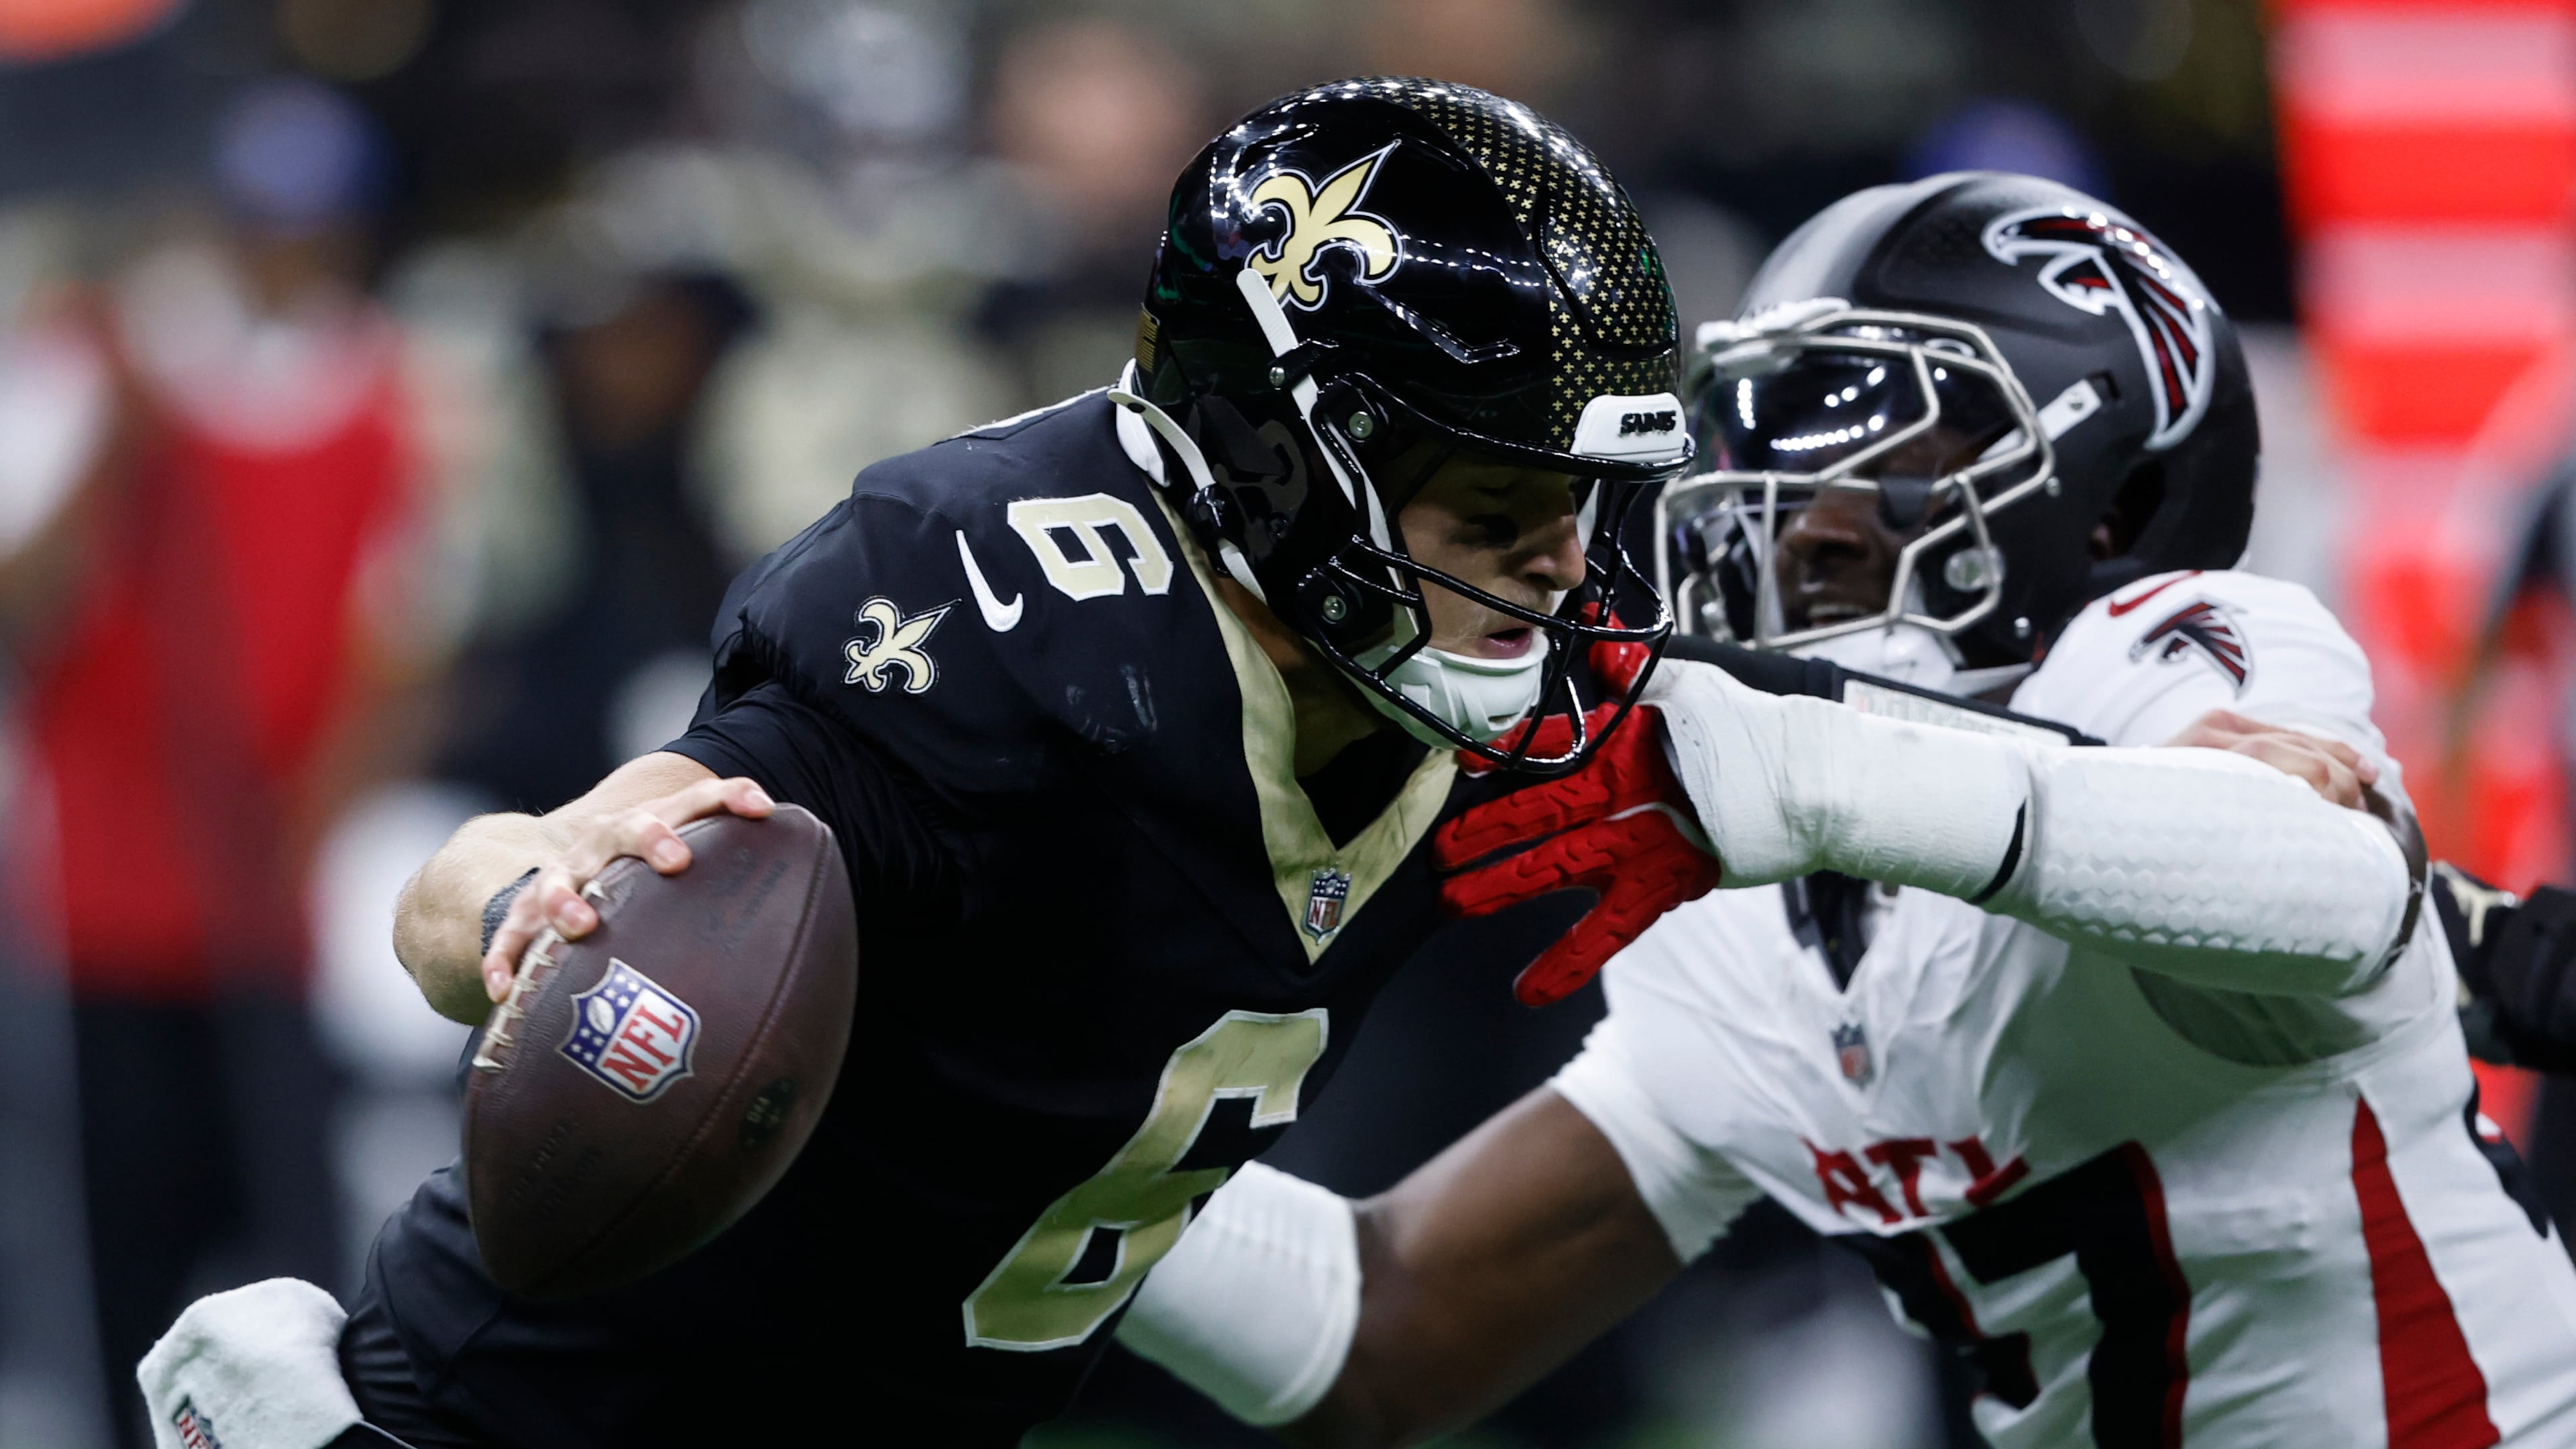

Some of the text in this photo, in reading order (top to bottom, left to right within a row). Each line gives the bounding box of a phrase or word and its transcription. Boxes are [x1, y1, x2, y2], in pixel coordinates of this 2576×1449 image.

[1008, 492, 1174, 602] 6
[602, 1004, 685, 1091] NFL
[962, 1008, 1329, 1352] 6
[1801, 1135, 2031, 1225] ATL
